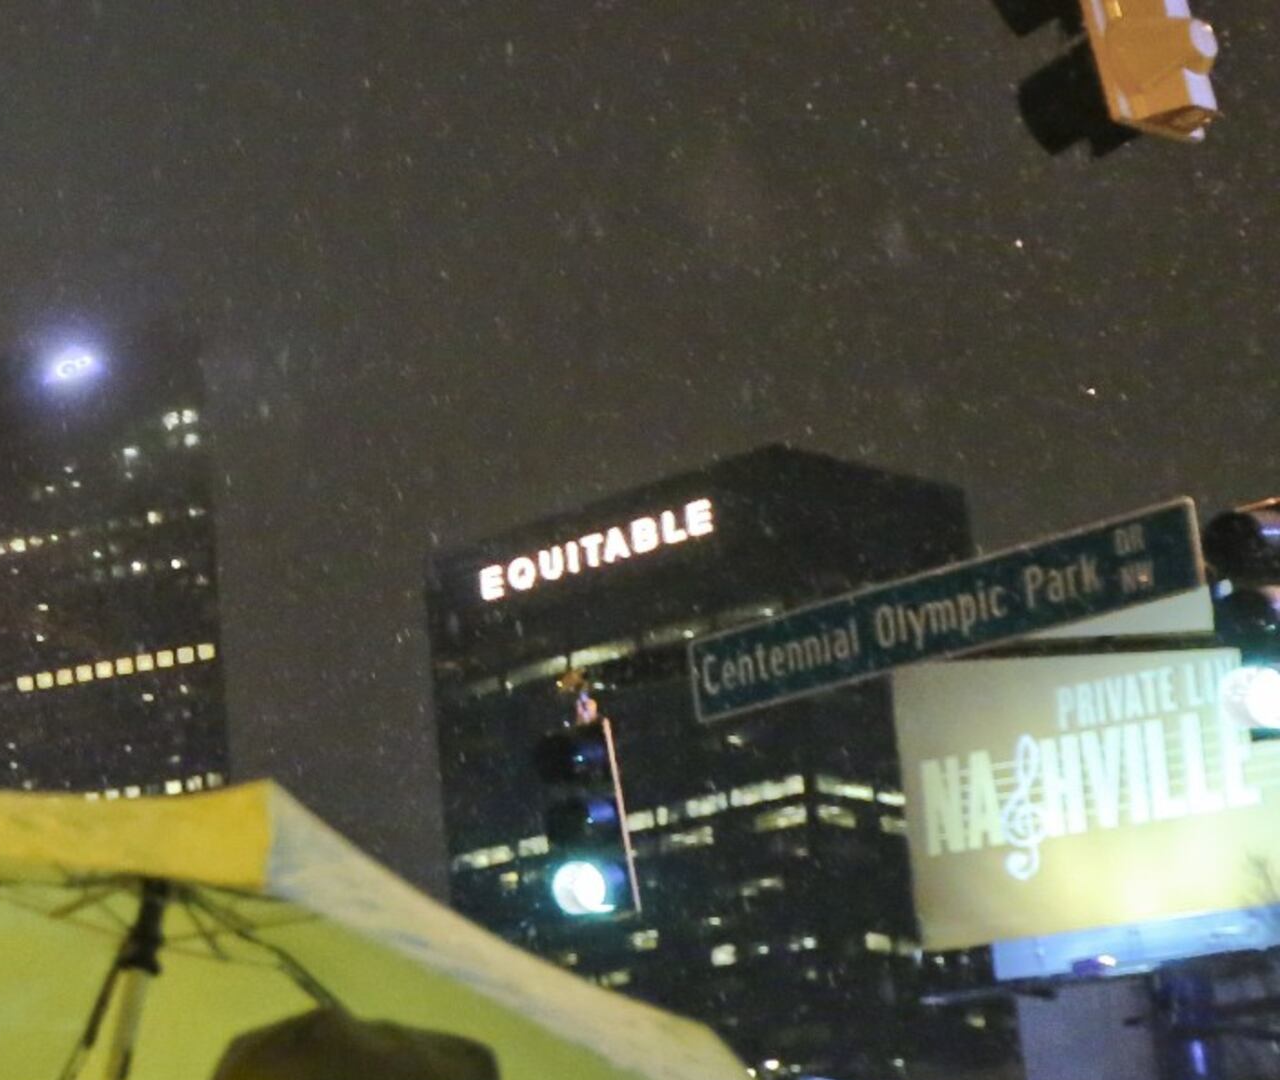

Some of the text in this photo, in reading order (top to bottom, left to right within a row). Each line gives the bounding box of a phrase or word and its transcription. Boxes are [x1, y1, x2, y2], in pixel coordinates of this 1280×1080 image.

[479, 498, 714, 600] EQUITABLE
[1114, 525, 1145, 556] DR
[1121, 559, 1154, 593] NW
[700, 556, 1100, 696] Centennial Olympic Park
[1055, 666, 1178, 731] PRIVATE
